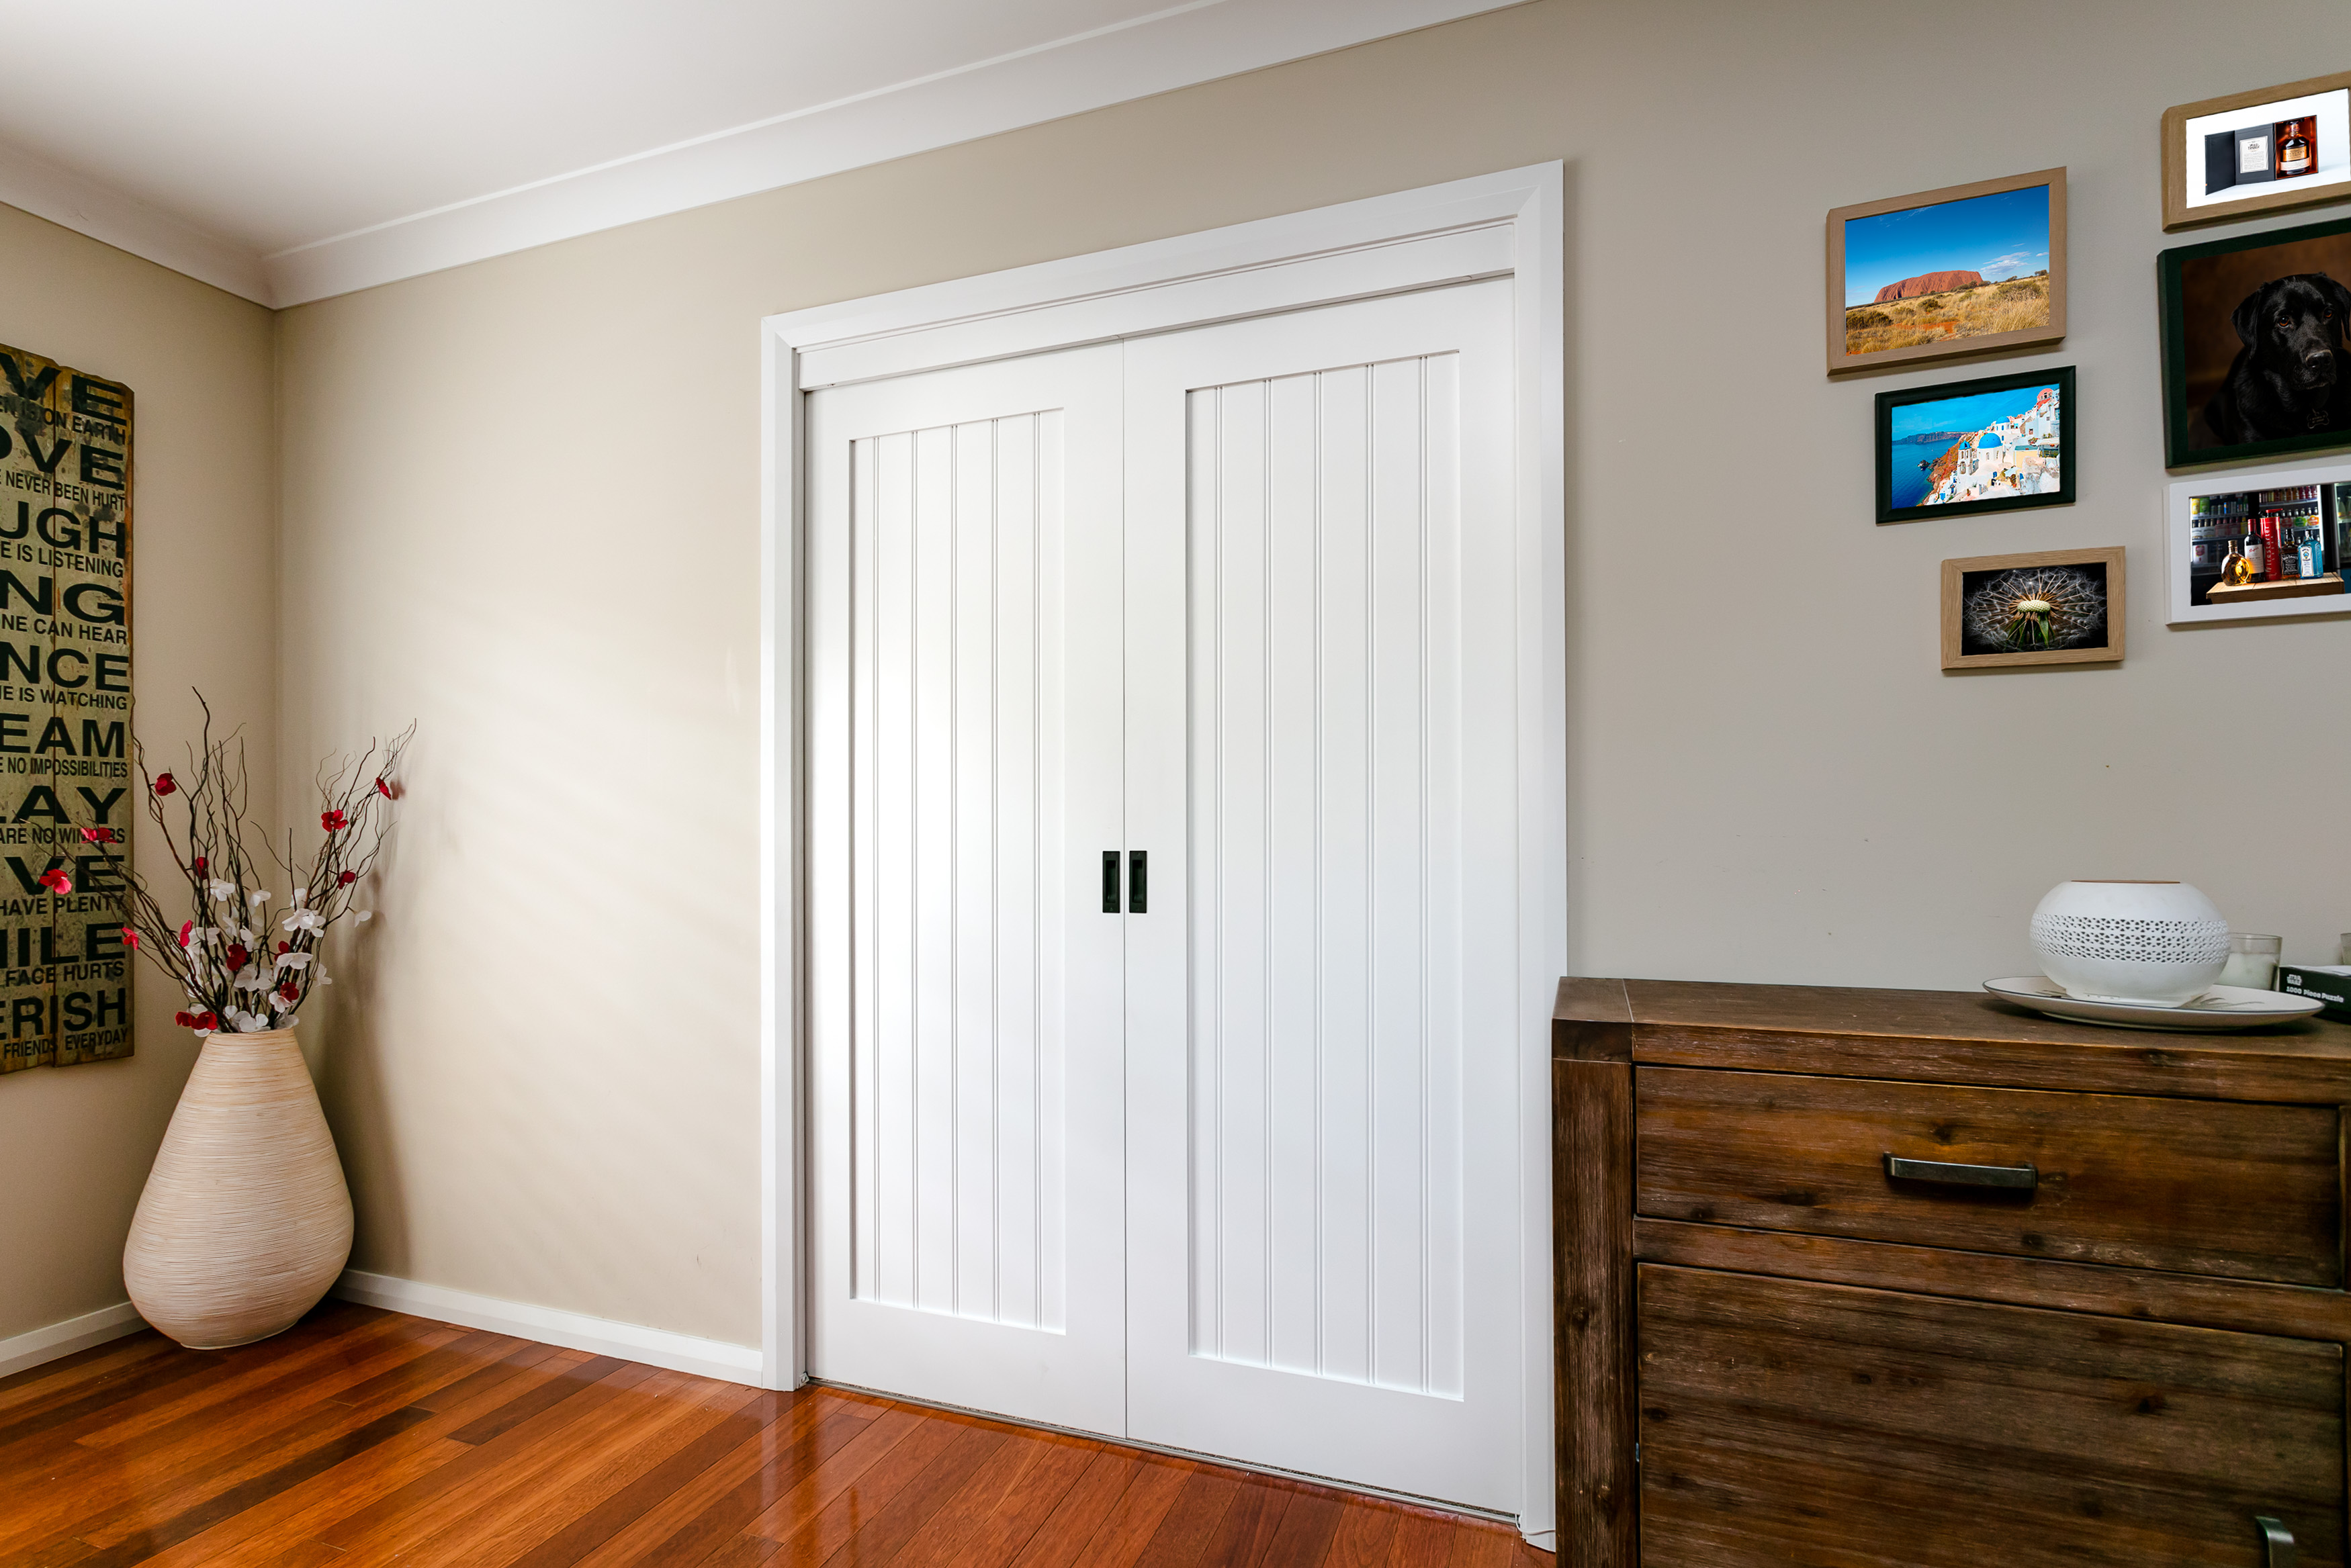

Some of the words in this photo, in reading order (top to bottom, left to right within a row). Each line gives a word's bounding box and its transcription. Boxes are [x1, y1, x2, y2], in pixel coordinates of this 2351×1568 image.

[44, 408, 66, 429] ON
[73, 416, 126, 445] EARTH
[0, 424, 126, 490] VE
[6, 470, 51, 496] NEVER
[54, 481, 89, 504] BEEN
[93, 490, 126, 511] HURT
[0, 501, 126, 559] UGH
[17, 543, 33, 563] IS
[39, 547, 124, 579] LISTENING
[0, 569, 126, 627] NG
[34, 618, 73, 639] CAN
[79, 625, 128, 645] HEAR
[0, 685, 13, 700] E
[19, 687, 35, 702] IS
[40, 688, 127, 710] WATCHING
[0, 713, 125, 758] EAM
[8, 757, 26, 774] NO
[30, 758, 128, 778] IMPOSSIBILITIES
[0, 785, 128, 825] AY
[34, 827, 54, 844] NO
[58, 827, 126, 844] WINS
[55, 894, 125, 914] PLENTY
[0, 922, 126, 969] ILE
[5, 967, 56, 987] FACE
[64, 960, 125, 982] HURTS
[2286, 986, 2302, 995] 1000
[2321, 993, 2344, 1003] Puzzle
[0, 988, 126, 1041] RISH
[4, 1038, 58, 1060] FRIENDS
[65, 1028, 128, 1051] EVERYDAY
